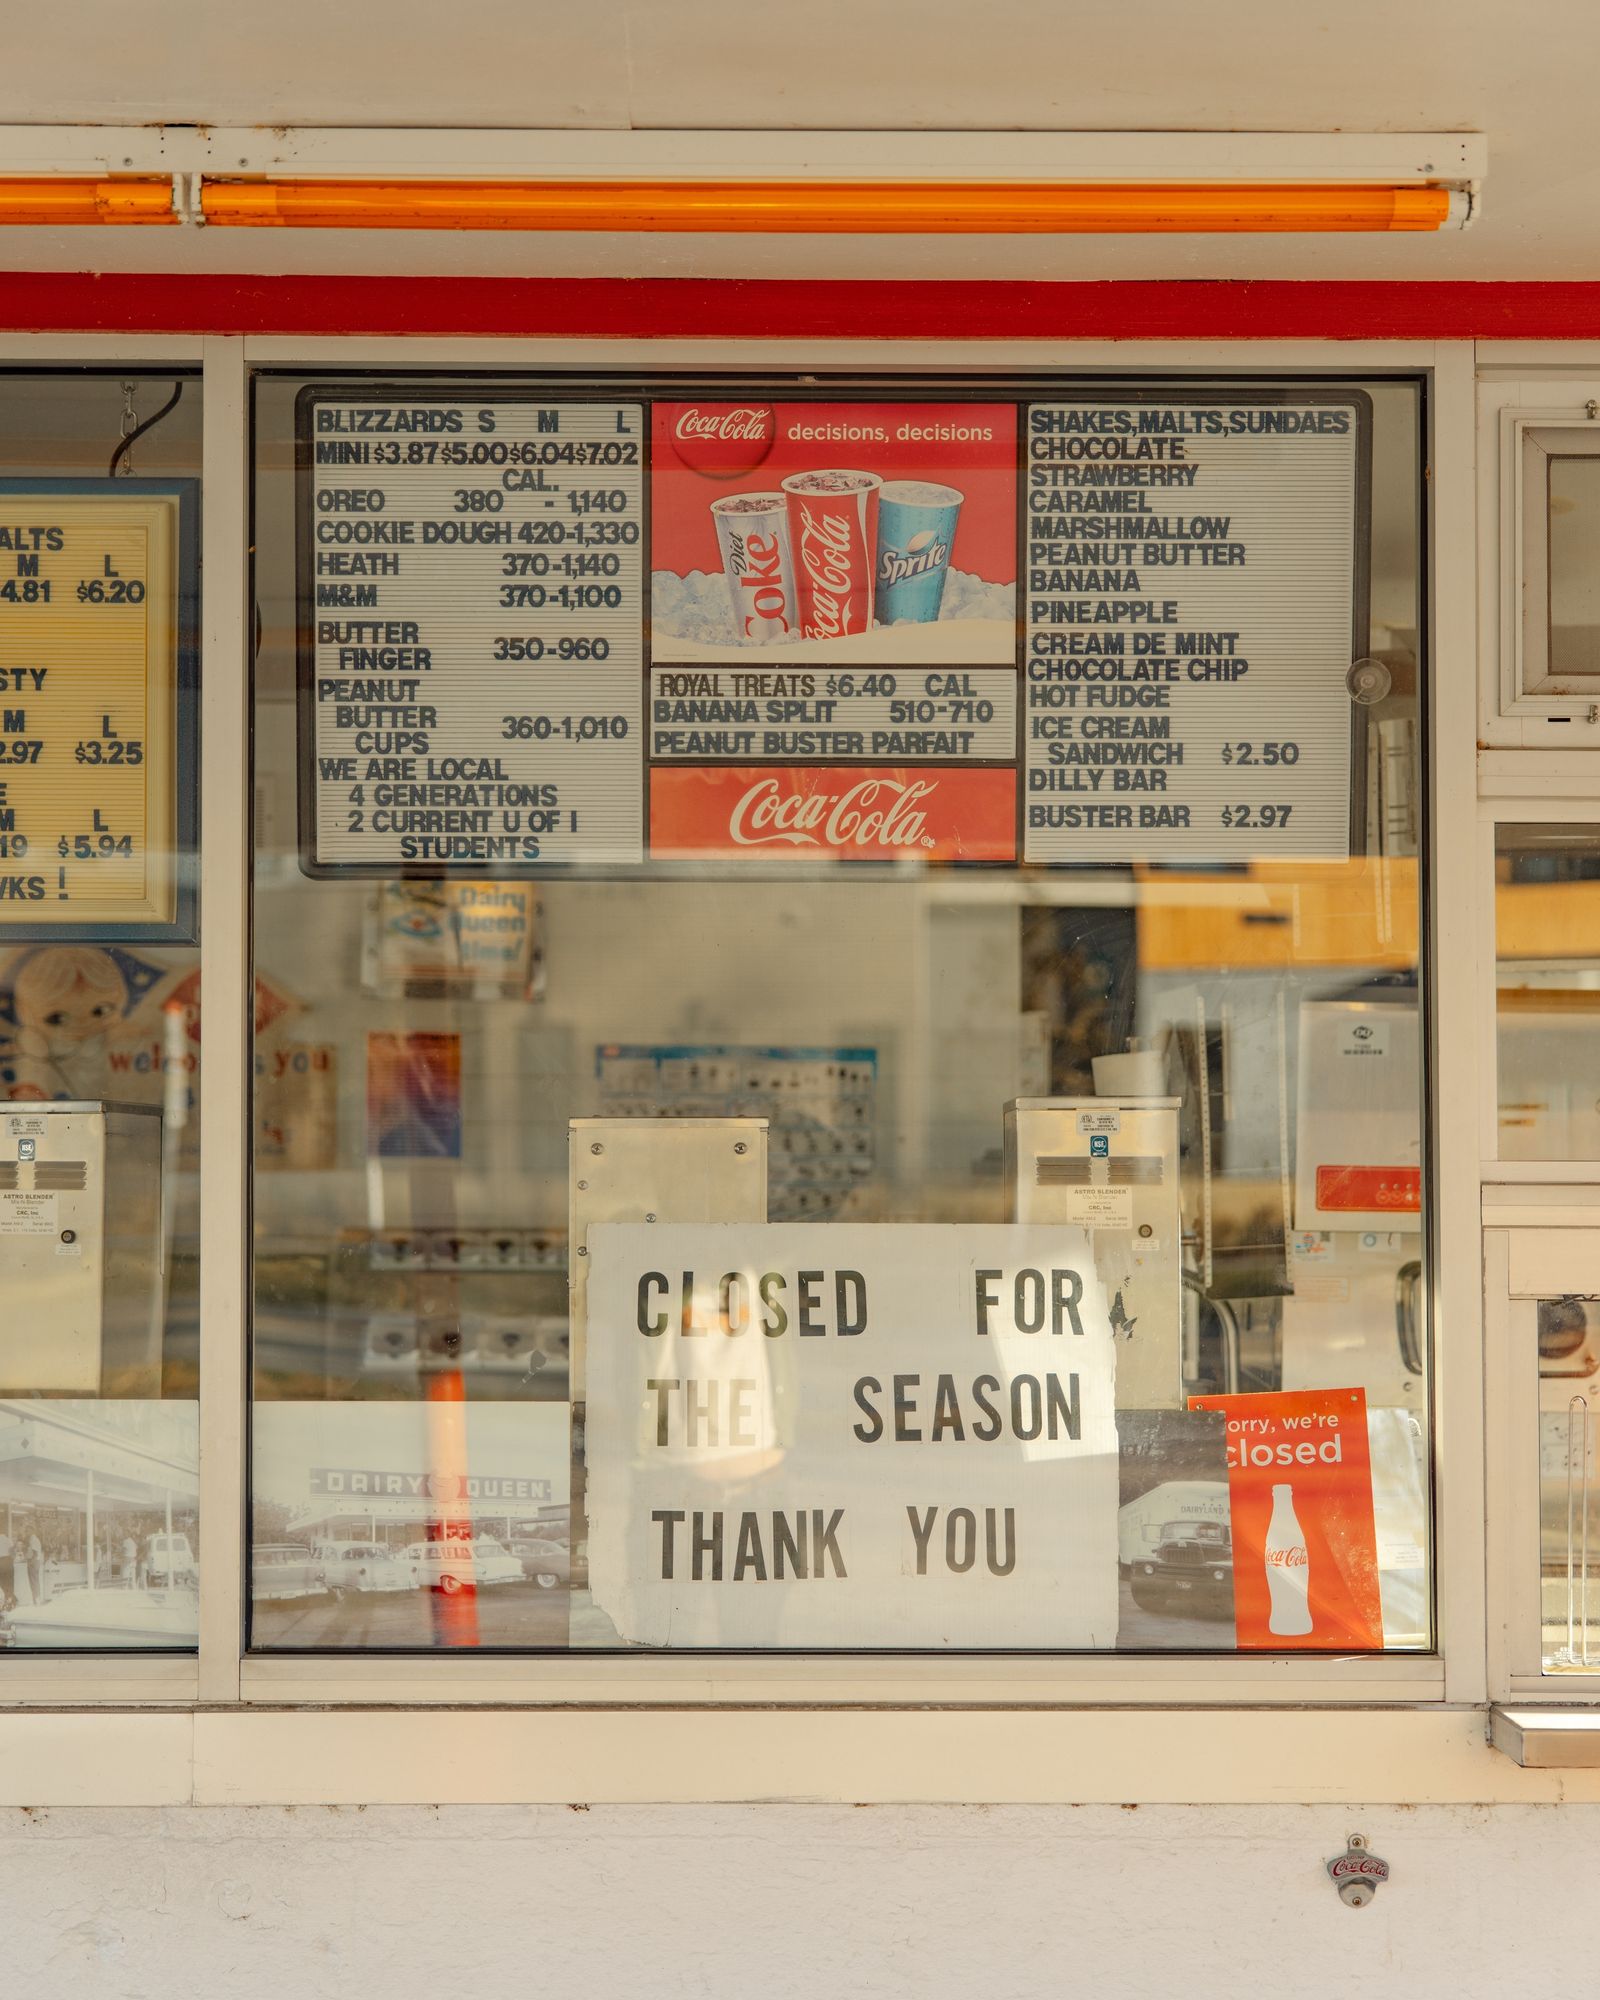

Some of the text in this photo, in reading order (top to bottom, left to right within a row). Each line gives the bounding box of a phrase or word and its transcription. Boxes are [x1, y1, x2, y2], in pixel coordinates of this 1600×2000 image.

[317, 410, 631, 433] BLIZZARDS S M L
[675, 408, 771, 440] Coca-Cola
[788, 422, 993, 443] decisions, decisions
[316, 441, 369, 465] MINI
[374, 441, 439, 465] $3.87
[1030, 437, 1185, 461] CHOCOLATE
[502, 469, 559, 492] CAL.
[1030, 464, 1199, 487] STRAWBERRY
[317, 490, 385, 512] OREO
[454, 490, 504, 512] 380
[567, 490, 627, 516] 1,140
[1029, 490, 1153, 513] CARAMEL
[0, 527, 64, 550] ALTS
[317, 521, 640, 548] COOKIE DOUGH 420-1,330
[1031, 516, 1230, 540] MARSHMALLOW
[729, 531, 746, 576] Diet
[878, 536, 947, 588] Sprite
[1030, 543, 1246, 566] PEANUT BUTTER
[17, 554, 119, 577] M L
[317, 552, 620, 579] HEATH 370-1,140
[0, 579, 145, 604] 4.81 $6.20
[1030, 569, 1141, 592] BANANA
[317, 584, 622, 611] M&M 370-1,100
[1031, 601, 1178, 624] PINEAPPLE
[318, 621, 419, 644] BUTTER
[1032, 632, 1239, 655] CREAM DE MINT
[339, 647, 432, 670] FINGER
[493, 637, 610, 661] 350-960
[1028, 658, 1249, 682] CHOCOLATE CHIP
[318, 679, 420, 702] PEANUT
[660, 674, 978, 698] ROYAL TREATS $6.40 CAL
[1030, 684, 1170, 708] HOT FUDGE
[336, 705, 437, 728] BUTTER
[654, 700, 994, 723] BANANA SPLIT 510-710
[3, 710, 117, 738] M L
[501, 715, 628, 743] 360-1,010
[1032, 716, 1170, 739] ICE CREAM
[75, 741, 143, 765] $3.25
[355, 731, 429, 755] CUPS
[654, 731, 975, 754] PEANUT BUSTER PARFAIT
[1047, 742, 1300, 766] SANDWICH $2.50
[318, 758, 509, 781] WE ARE LOCAL
[1029, 769, 1167, 792] DILLY BAR
[349, 784, 558, 807] 4 GENERATIONS
[93, 809, 108, 832] L
[348, 810, 578, 833] 2 CURRENT U OF I
[729, 778, 940, 847] Coca-Cola
[1029, 805, 1293, 828] BUSTER BAR $2.97
[57, 835, 132, 859] $5.94
[400, 836, 540, 859] STUDENTS
[636, 1268, 1085, 1338] CLOSED FOR
[646, 1372, 1082, 1448] THE SEASON
[1228, 1418, 1276, 1434] orry,
[1226, 1433, 1342, 1468] closed
[327, 1472, 544, 1498] DAIRY QUEEN
[651, 1505, 1017, 1581] THANK YOU
[1333, 1859, 1388, 1877] Coca-Cola
